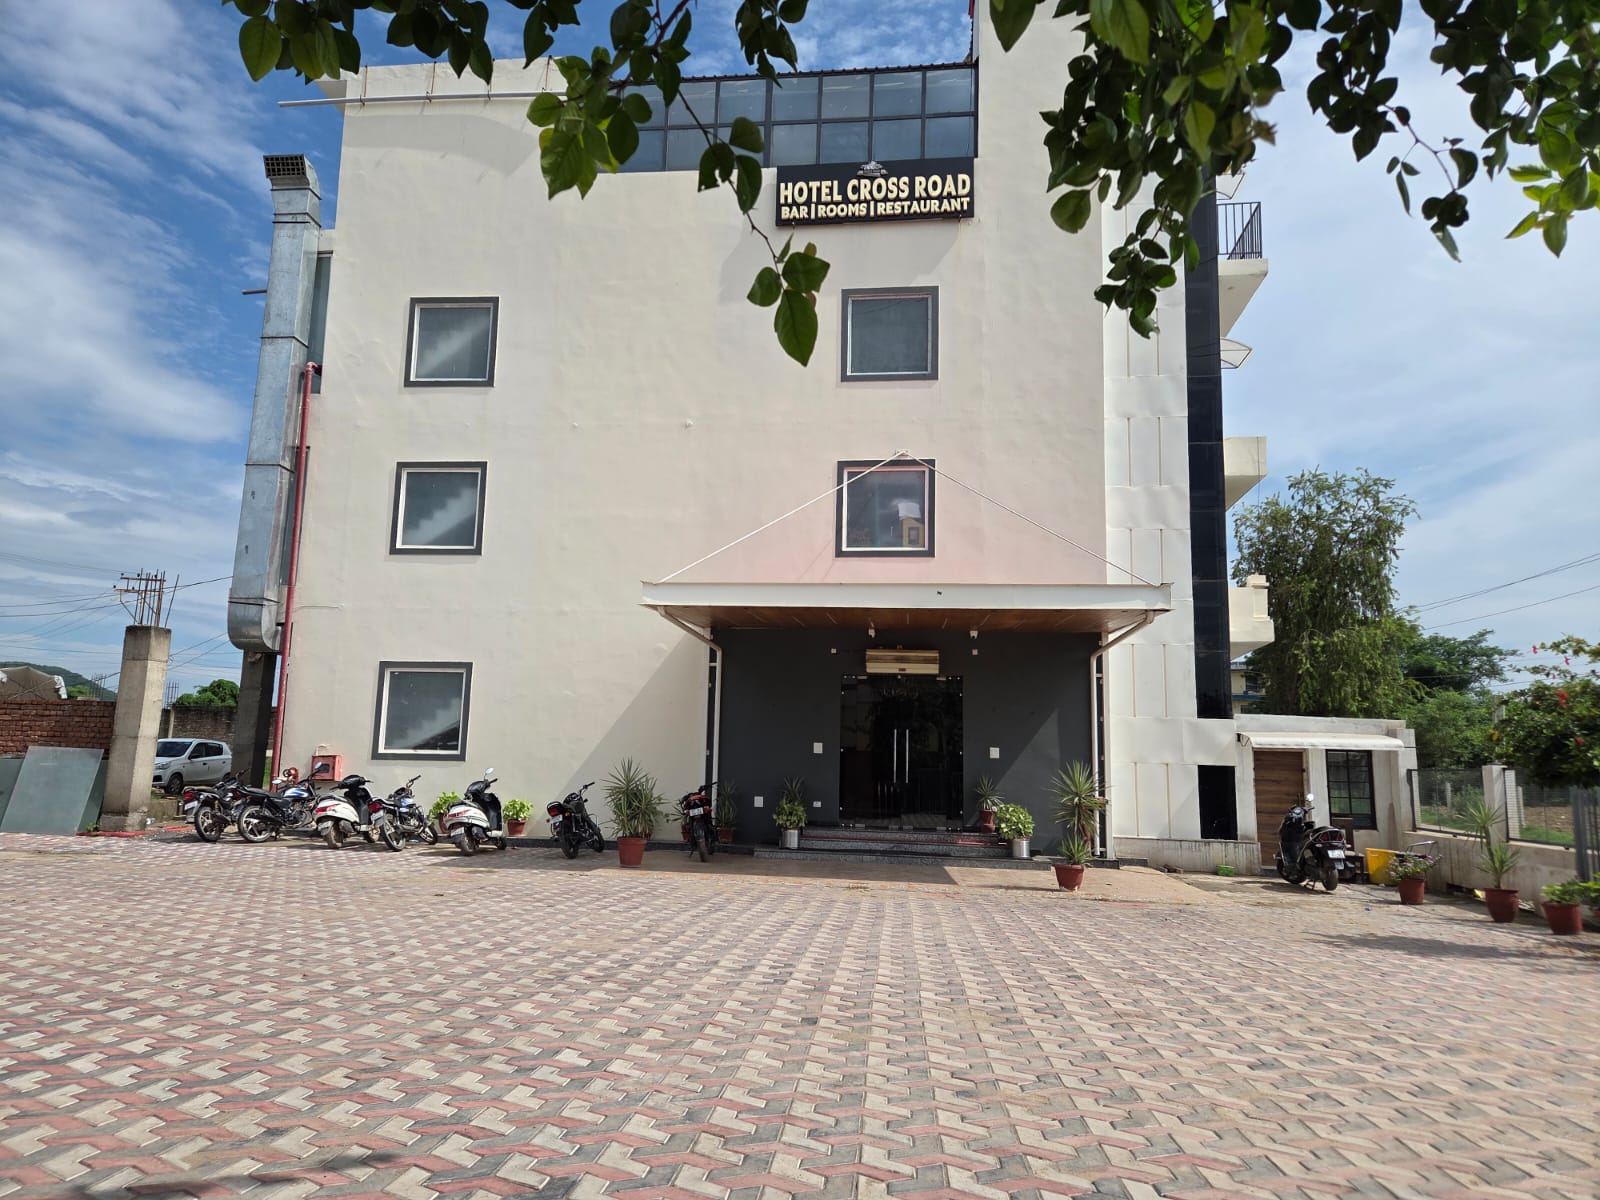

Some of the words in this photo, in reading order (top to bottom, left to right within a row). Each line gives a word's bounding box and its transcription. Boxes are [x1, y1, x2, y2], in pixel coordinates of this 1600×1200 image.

[780, 180, 843, 204] HOTEL
[847, 177, 910, 201] CROSS
[914, 174, 971, 198] ROAD
[781, 205, 809, 220] BAR
[817, 203, 867, 217] ROOMS
[877, 197, 970, 215] RESTAURANT
